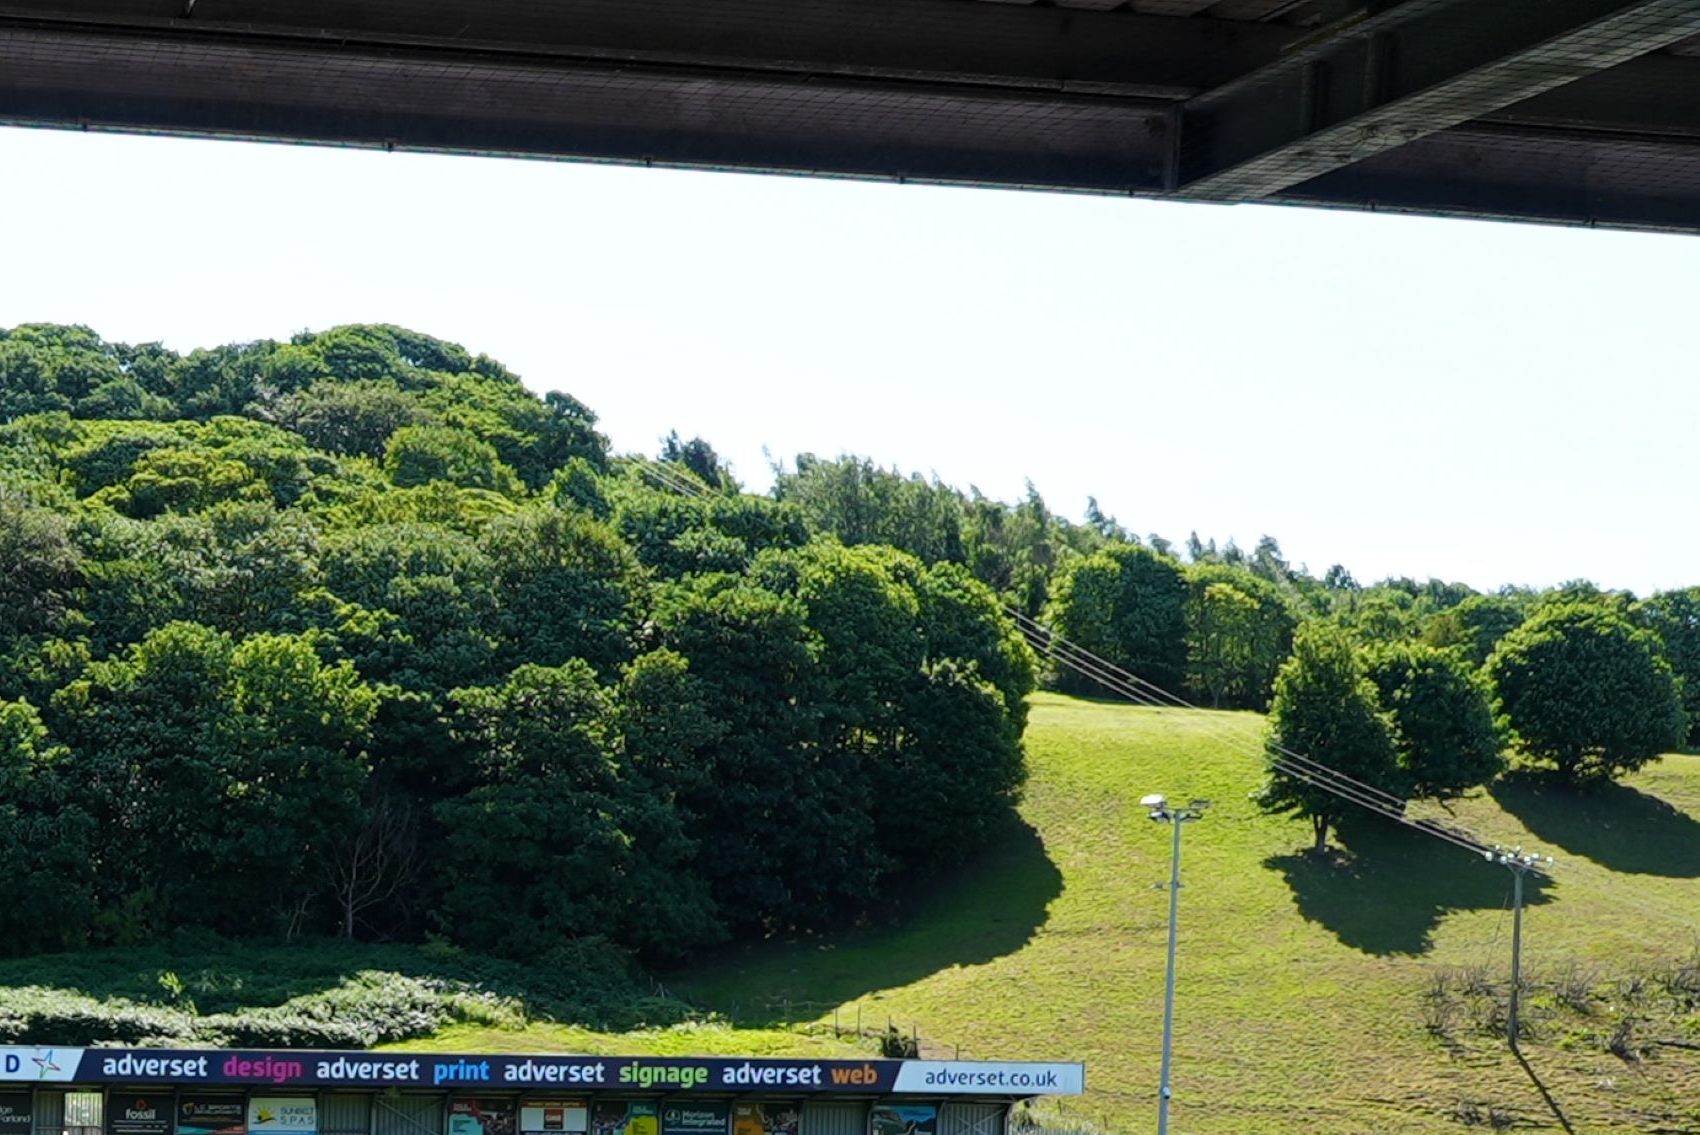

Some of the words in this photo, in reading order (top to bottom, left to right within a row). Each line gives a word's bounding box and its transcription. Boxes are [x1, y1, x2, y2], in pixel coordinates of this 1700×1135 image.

[103, 1053, 208, 1076] adverset
[223, 1055, 302, 1083] design
[317, 1057, 419, 1080] adverset
[433, 1059, 490, 1084] print
[504, 1060, 605, 1083] adverset
[619, 1061, 708, 1088] signage
[722, 1062, 822, 1085] adverset
[831, 1063, 878, 1085] web
[925, 1068, 1058, 1088] adverset.co.uk
[125, 1108, 157, 1120] fossil
